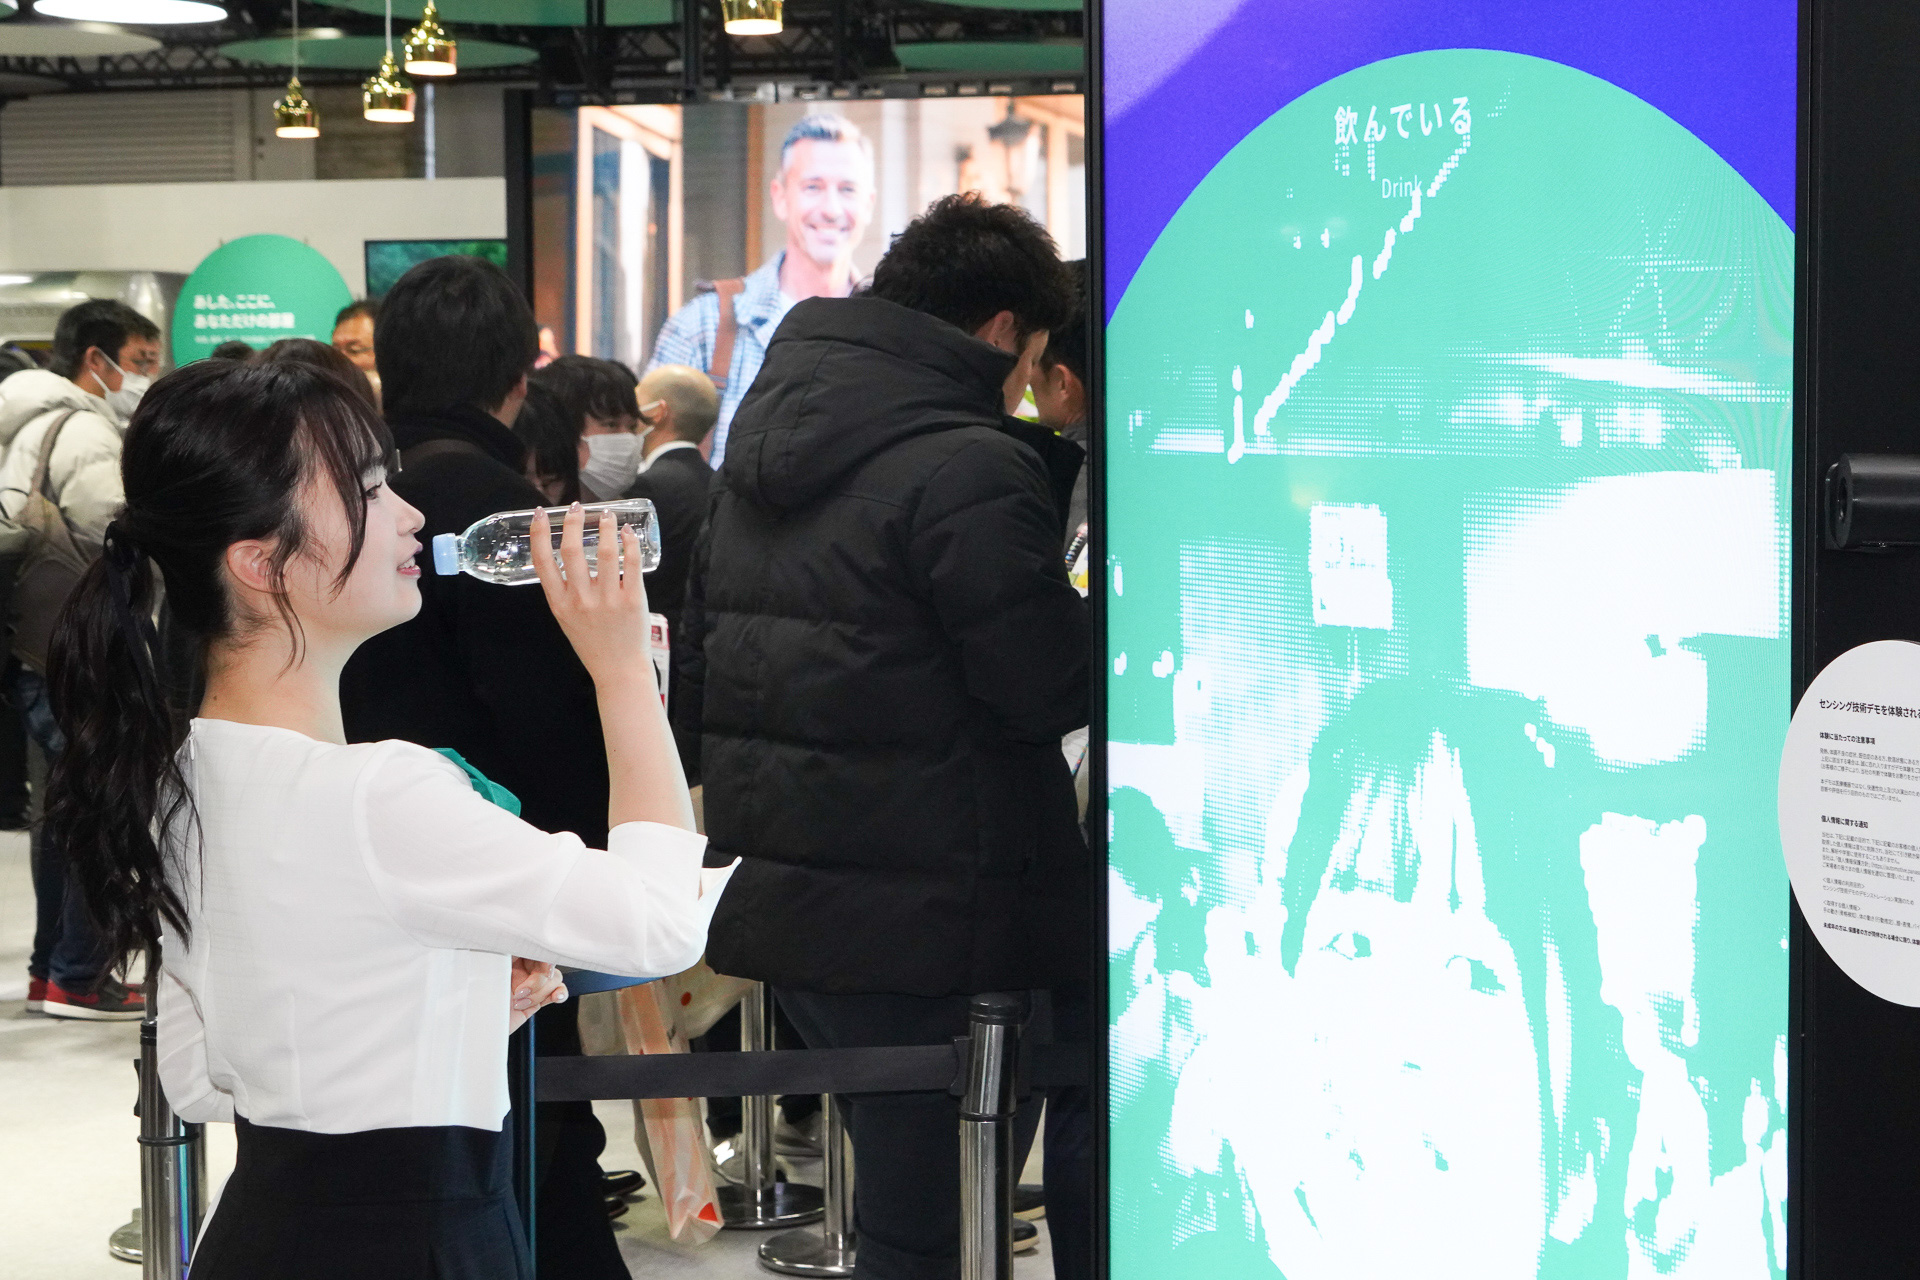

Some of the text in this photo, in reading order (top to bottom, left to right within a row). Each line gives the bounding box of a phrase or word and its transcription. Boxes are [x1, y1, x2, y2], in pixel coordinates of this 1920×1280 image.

[1334, 96, 1471, 145] 飲んでいる
[1382, 175, 1422, 198] Drink
